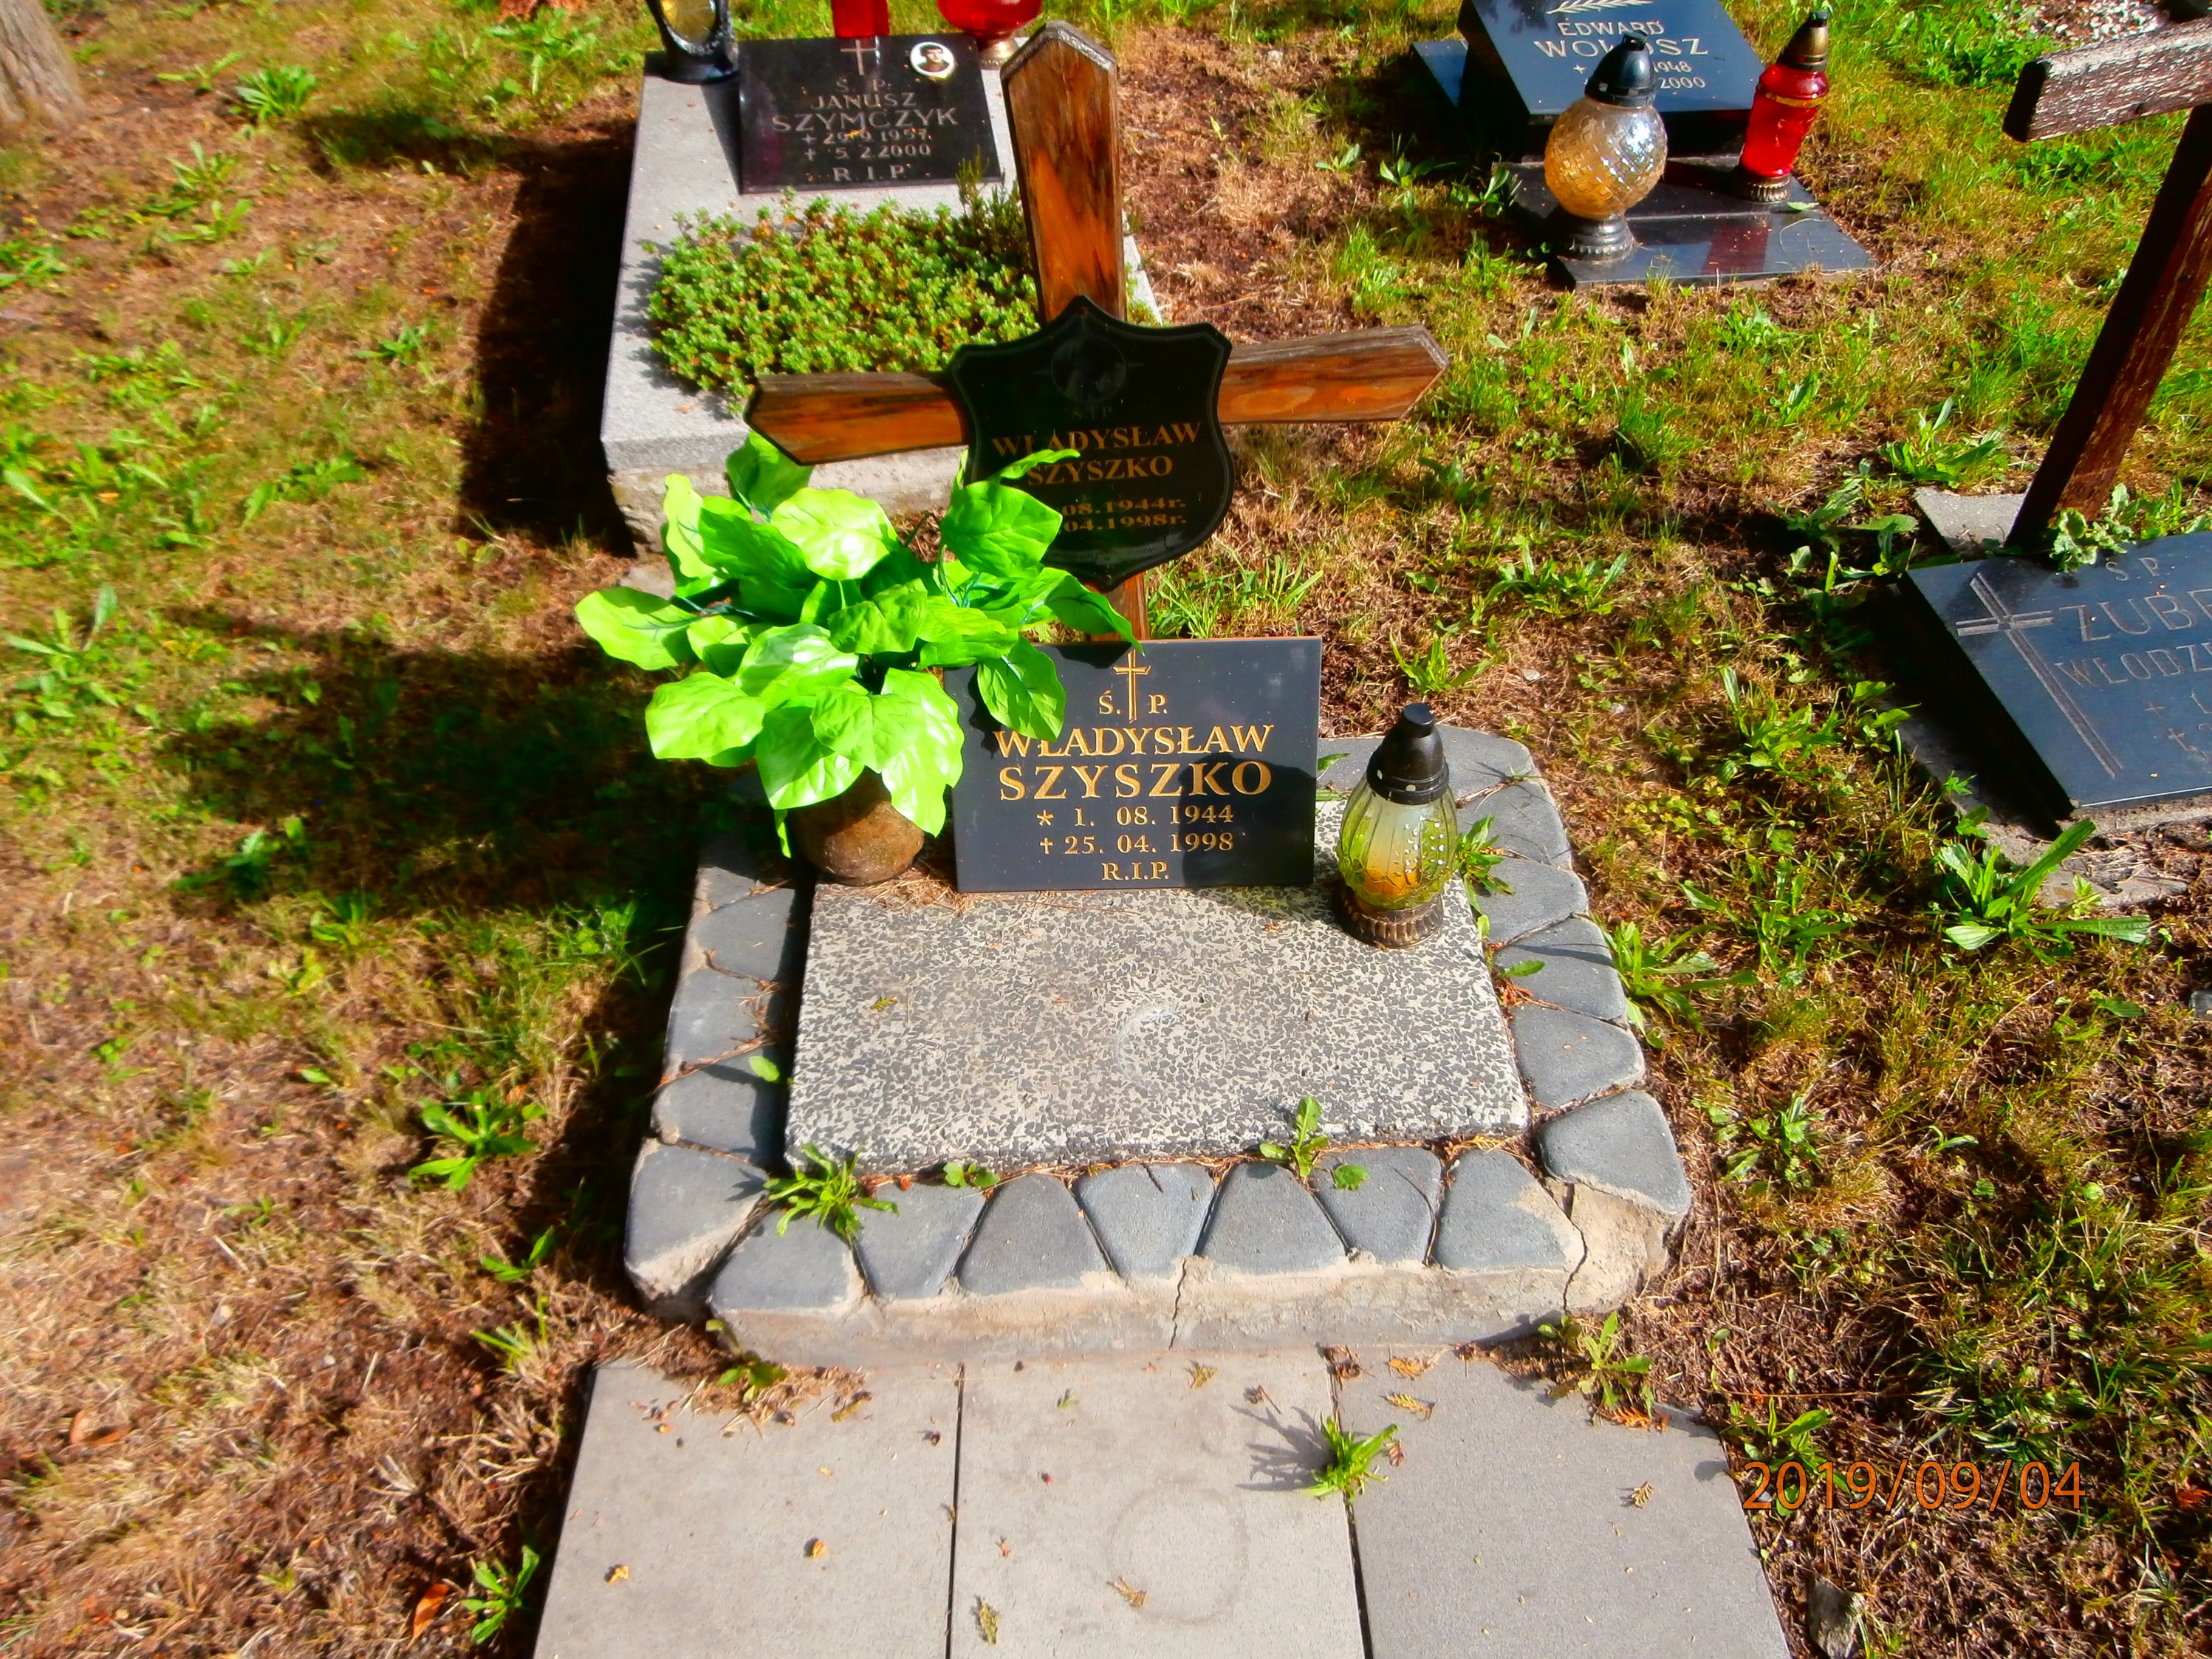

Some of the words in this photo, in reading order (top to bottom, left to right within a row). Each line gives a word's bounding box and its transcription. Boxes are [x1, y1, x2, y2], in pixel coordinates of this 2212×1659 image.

[1556, 21, 1665, 37] EDWARD
[1533, 38, 1708, 58] WOŁSZ
[1653, 61, 1693, 73] 1948
[1658, 76, 1706, 89] 2000
[811, 92, 917, 109] JANUSZ
[772, 107, 959, 132] SZYMCZYK
[992, 422, 1201, 458] WŁADYSŁAW
[1027, 455, 1174, 485] SZYSZKO
[1062, 497, 1186, 516] 08.1944r.
[1064, 515, 1187, 533] 04.1998r.
[1098, 690, 1121, 715] Ś.
[1148, 694, 1168, 714] P.
[993, 724, 1275, 759] WŁADYSŁAW
[999, 760, 1272, 801] SZYSZKO
[1116, 806, 1156, 827] 08.
[1170, 804, 1234, 825] 1944
[1064, 835, 1104, 855] 25.
[1117, 835, 1157, 854] 04.
[1170, 832, 1234, 852] 1998
[1102, 861, 1170, 882] R.I.P.
